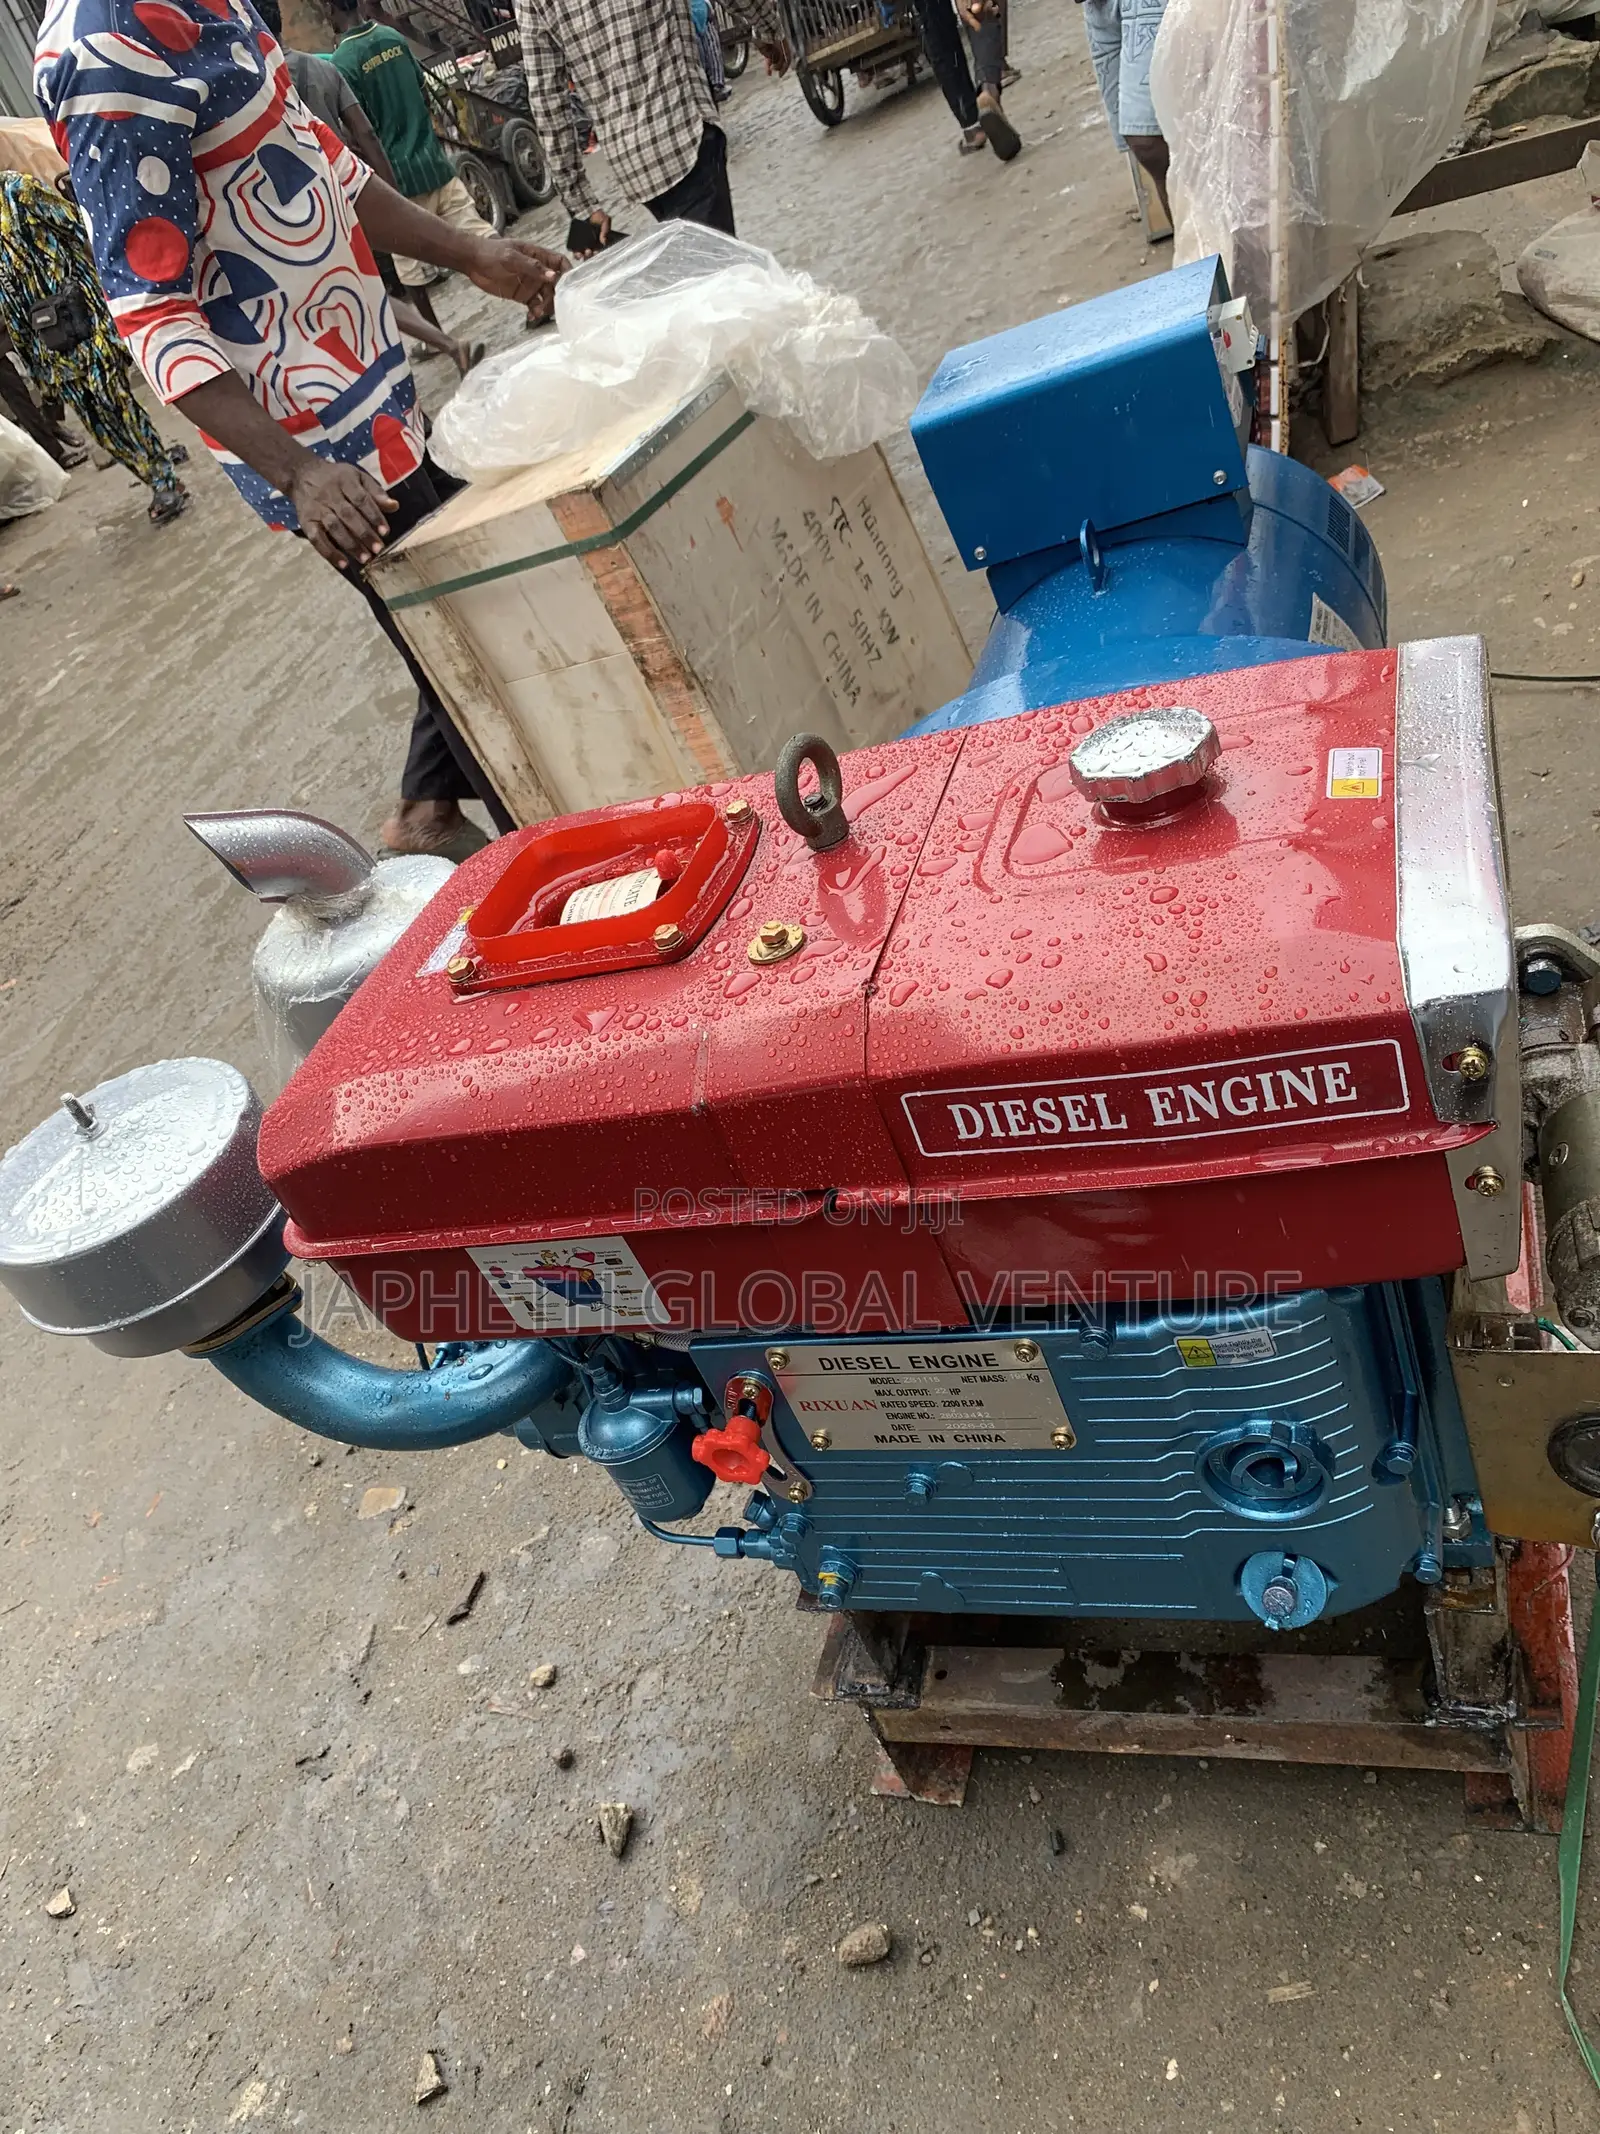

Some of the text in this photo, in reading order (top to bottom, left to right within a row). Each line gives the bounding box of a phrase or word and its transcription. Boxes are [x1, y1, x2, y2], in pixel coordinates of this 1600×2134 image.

[490, 34, 508, 52] NO
[804, 591, 824, 624] IN
[822, 630, 862, 708] CHINA
[946, 1061, 1358, 1140] DIESEL ENGINE
[818, 1353, 999, 1371] DIESEL ENGINE
[868, 1377, 901, 1385] MODEL:
[961, 1375, 978, 1384] NET
[979, 1374, 1008, 1384] MASS:
[874, 1389, 896, 1397] MAX.
[897, 1388, 931, 1397] OUTPUT:
[949, 1388, 961, 1396] HP
[798, 1400, 879, 1412] RIXUAN
[880, 1400, 908, 1409] RATED
[908, 1400, 939, 1408] SPEED:
[941, 1400, 960, 1408] 2200
[885, 1412, 918, 1421] ENGINE
[890, 1422, 916, 1432] DATE:
[873, 1433, 1007, 1444] MADE IN CHINA
